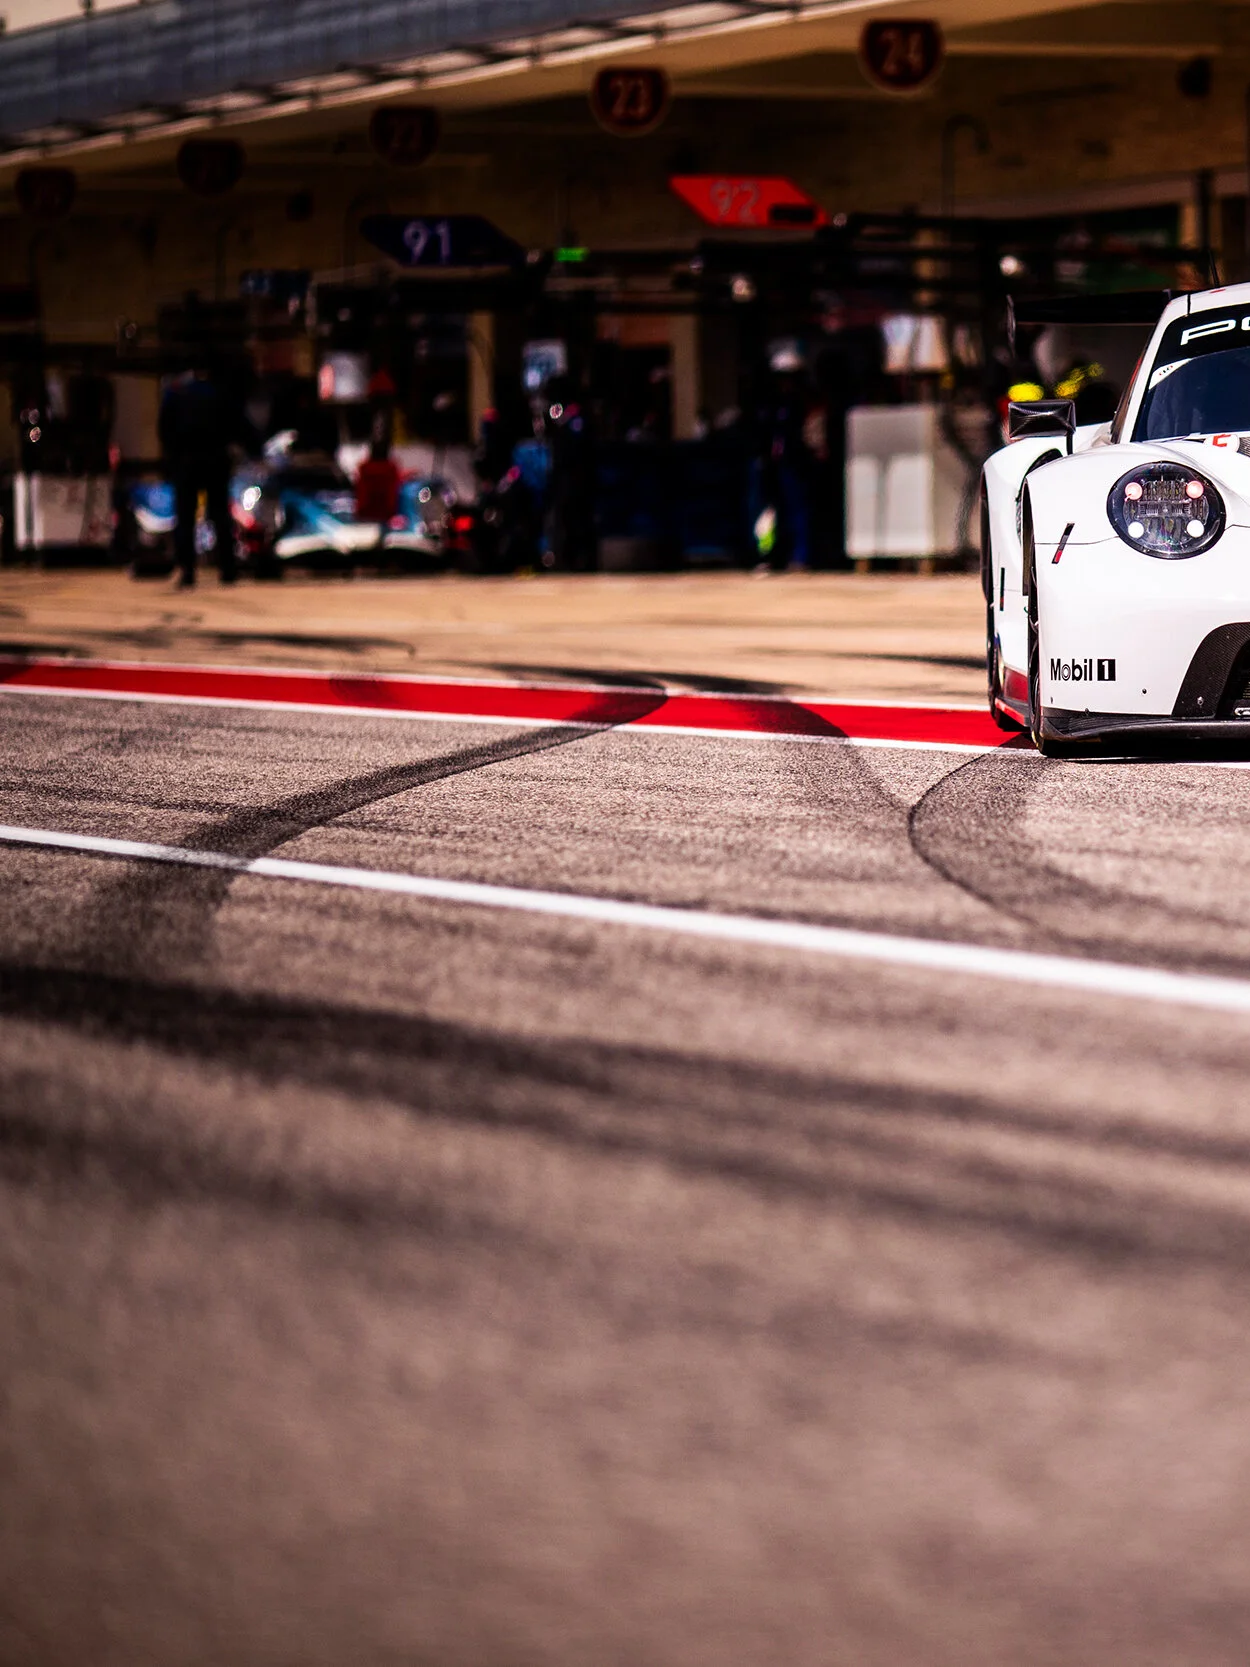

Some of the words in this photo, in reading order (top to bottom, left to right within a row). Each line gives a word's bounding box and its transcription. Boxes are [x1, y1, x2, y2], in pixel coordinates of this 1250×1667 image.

[880, 29, 922, 75] 24
[609, 77, 650, 118] 23
[710, 180, 759, 223] 92
[404, 220, 451, 264] 91
[1050, 658, 1093, 681] Mobil
[1100, 660, 1112, 681] 1
